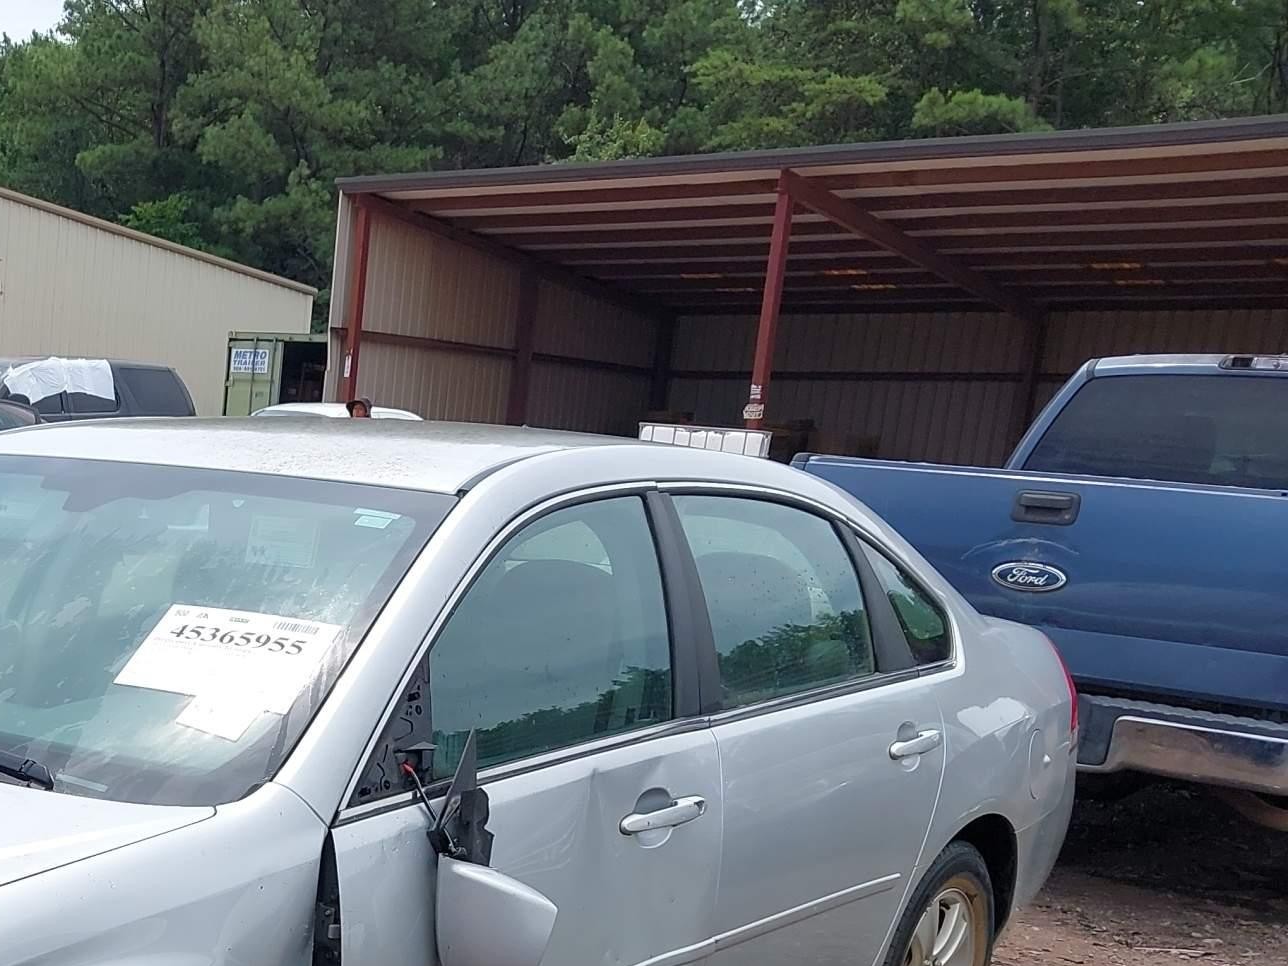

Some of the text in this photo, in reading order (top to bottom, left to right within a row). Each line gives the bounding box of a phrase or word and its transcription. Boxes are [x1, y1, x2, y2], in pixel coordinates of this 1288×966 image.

[233, 350, 268, 360] METRO
[1007, 567, 1049, 586] Ford
[170, 624, 308, 656] 45365955
